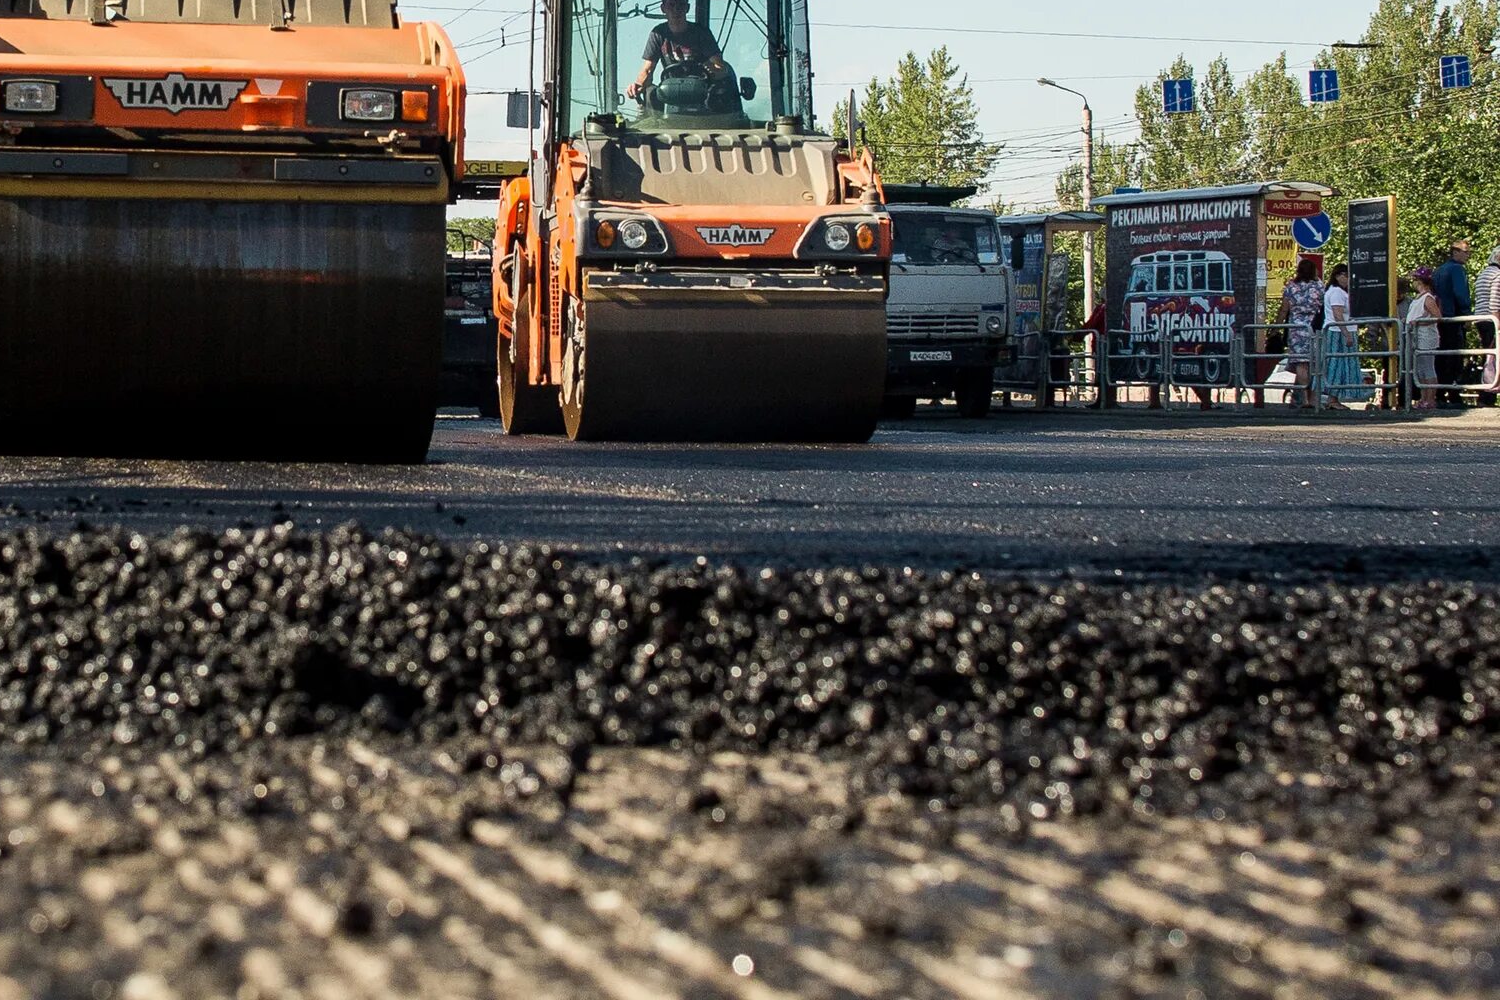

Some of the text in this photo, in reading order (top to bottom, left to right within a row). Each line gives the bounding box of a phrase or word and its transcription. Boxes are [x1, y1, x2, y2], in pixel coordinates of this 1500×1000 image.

[126, 81, 224, 106] HAMM
[1111, 200, 1251, 227] РЕКЛАМА НА ТРАНСПОРТЕ
[1272, 202, 1313, 211] АЛОЕ ПОЛЕ
[708, 229, 763, 243] HAMM
